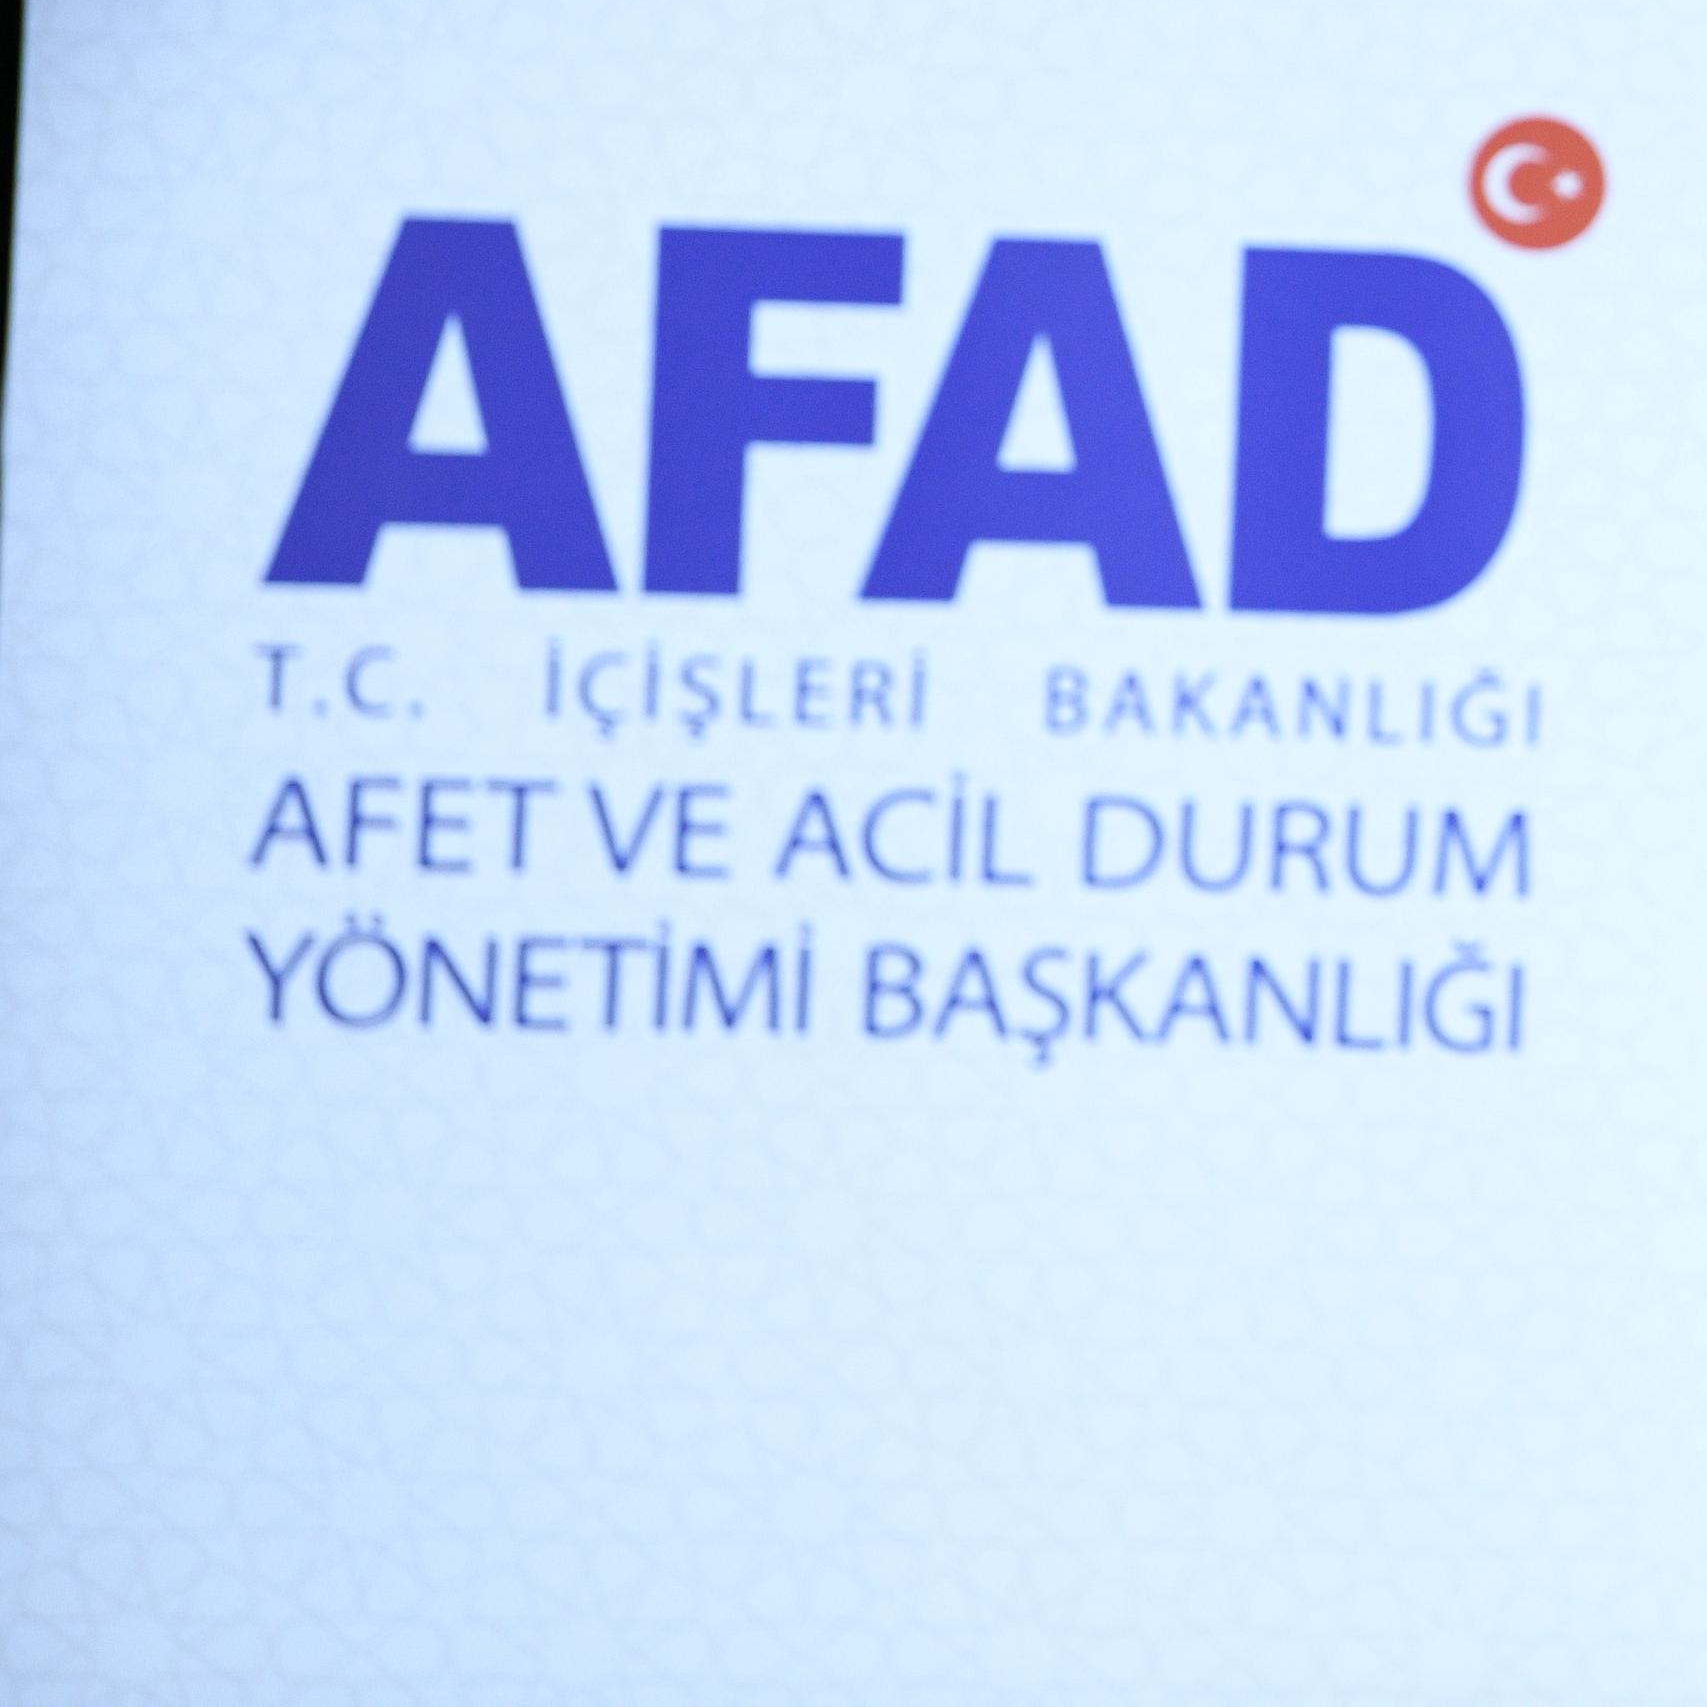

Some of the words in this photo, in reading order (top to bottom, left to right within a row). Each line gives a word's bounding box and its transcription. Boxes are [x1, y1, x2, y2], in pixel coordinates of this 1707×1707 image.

[261, 212, 1530, 620] AFAD
[252, 641, 426, 720] T.C.
[543, 636, 928, 742] İÇİŞLERİ
[1043, 662, 1542, 749] BAKANLIĞI
[247, 774, 558, 873] AFET
[586, 781, 731, 880] VE
[772, 769, 1034, 887] ACİL
[1081, 792, 1531, 900] DURUM
[243, 911, 815, 1035] YÖNETİMİ
[863, 939, 1527, 1070] BAŞKANLIĞI
